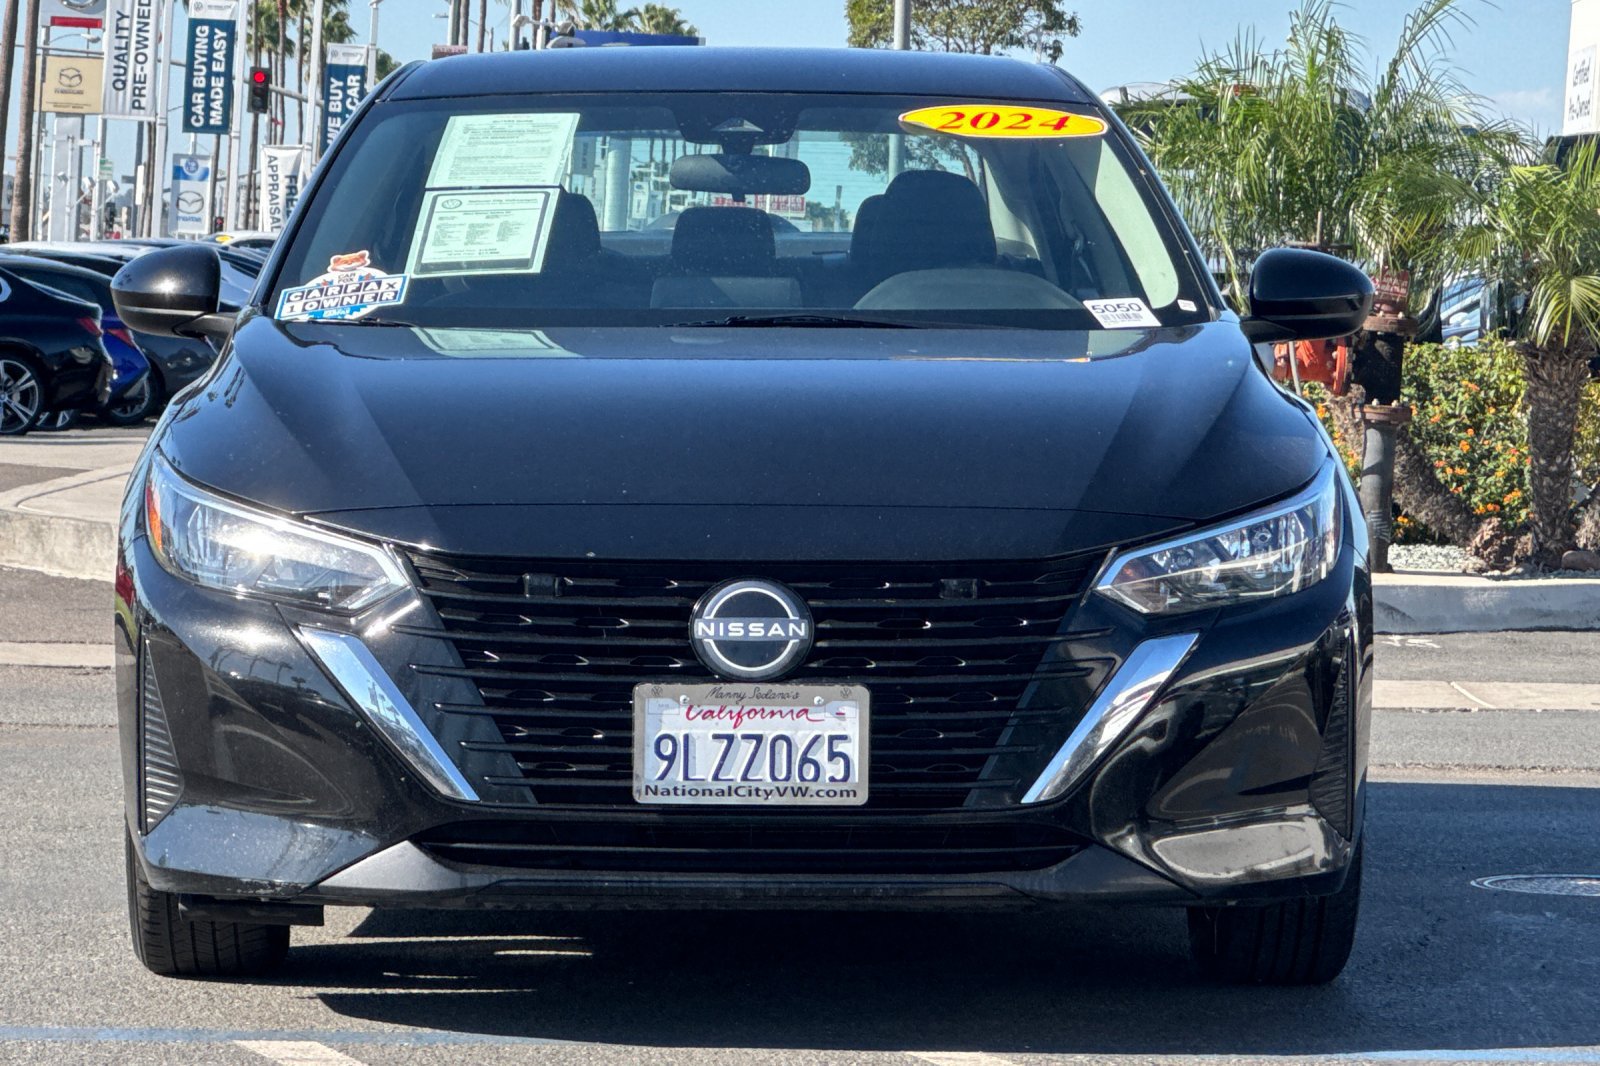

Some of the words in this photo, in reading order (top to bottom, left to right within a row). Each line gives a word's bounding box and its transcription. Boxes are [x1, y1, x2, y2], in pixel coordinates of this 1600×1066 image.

[112, 10, 130, 92] QUALITY
[131, 0, 152, 111] PRE-OWNED
[193, 25, 210, 89] BUYING
[211, 28, 228, 73] EASY
[209, 76, 225, 126] MADE
[328, 77, 344, 113] BUY
[346, 74, 361, 109] CAR
[191, 93, 206, 128] CAR
[935, 111, 1069, 132] 2024
[267, 154, 281, 232] APPRAISAL
[285, 174, 298, 219] FRE
[286, 304, 296, 313] 1
[304, 291, 395, 311] OWNER
[289, 281, 397, 301] CARFAX
[1091, 302, 1142, 314] 5050
[697, 622, 806, 637] NISSAN
[705, 686, 746, 704] Manny
[685, 704, 826, 730] California
[653, 733, 850, 783] 9LZZ065
[644, 784, 858, 800] NationalCityVW.com
